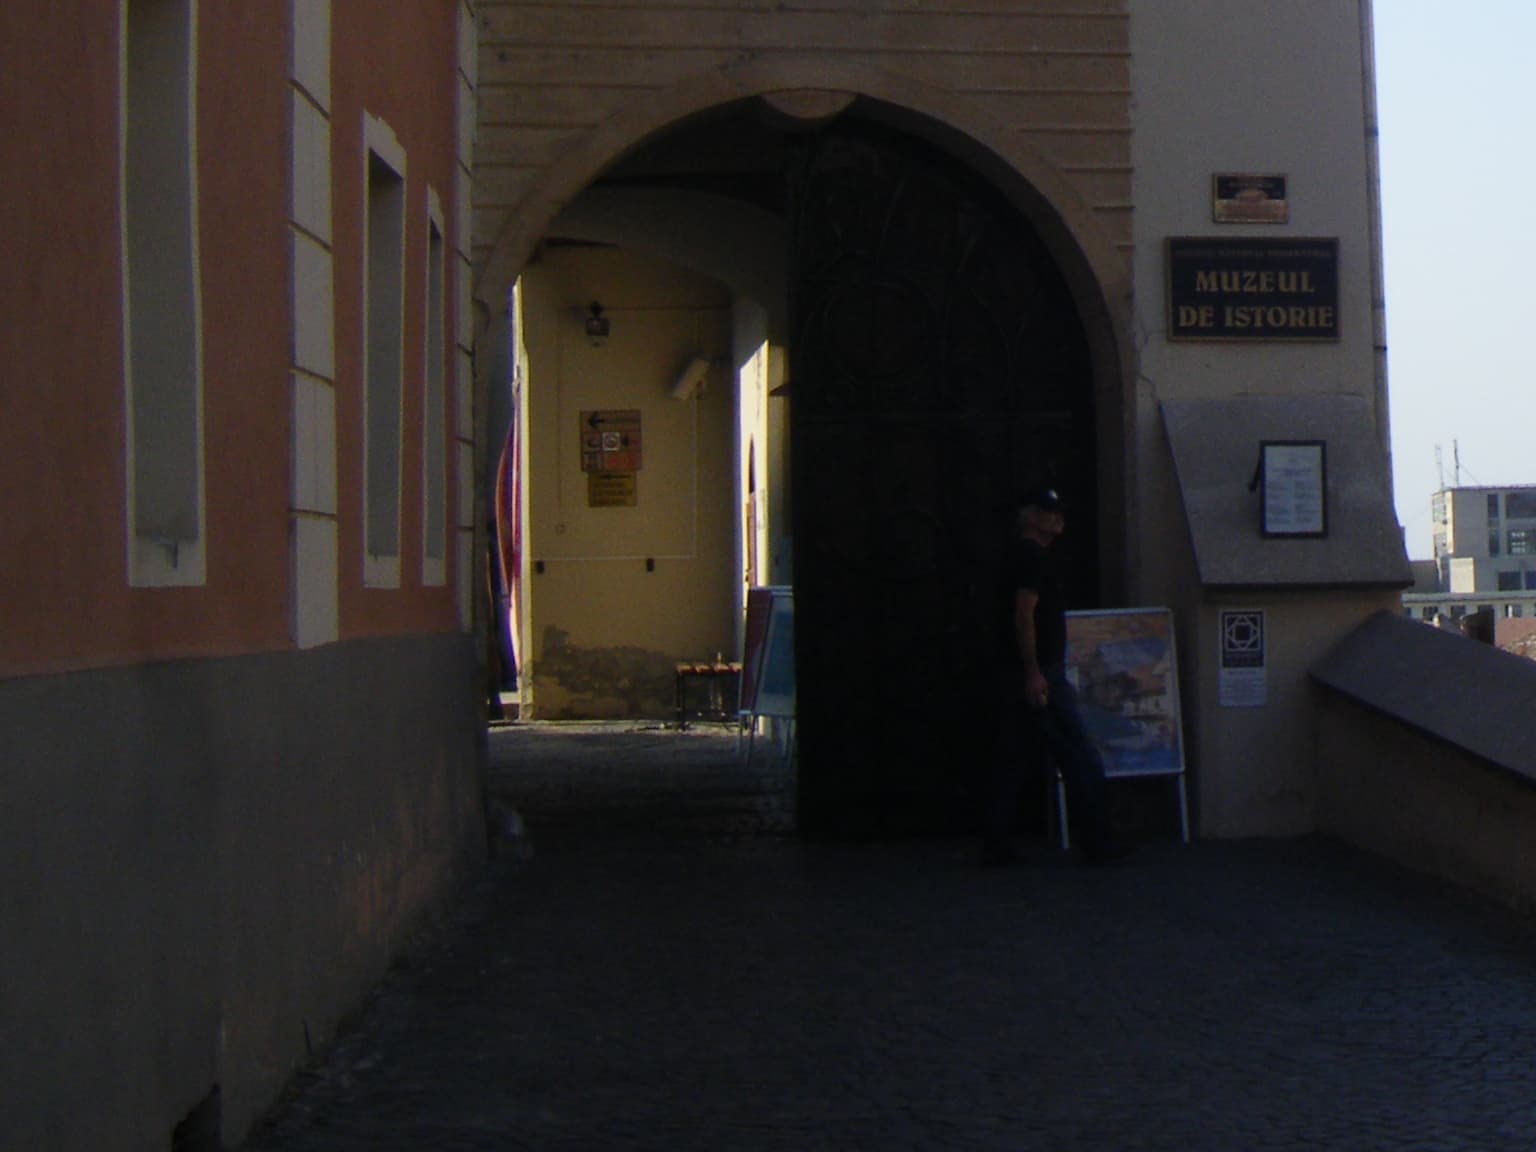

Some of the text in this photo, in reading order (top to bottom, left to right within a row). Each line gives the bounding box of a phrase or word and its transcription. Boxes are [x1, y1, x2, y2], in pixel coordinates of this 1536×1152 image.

[1195, 271, 1315, 293] MUZEUL
[1178, 305, 1334, 328] DE ISTORIE
